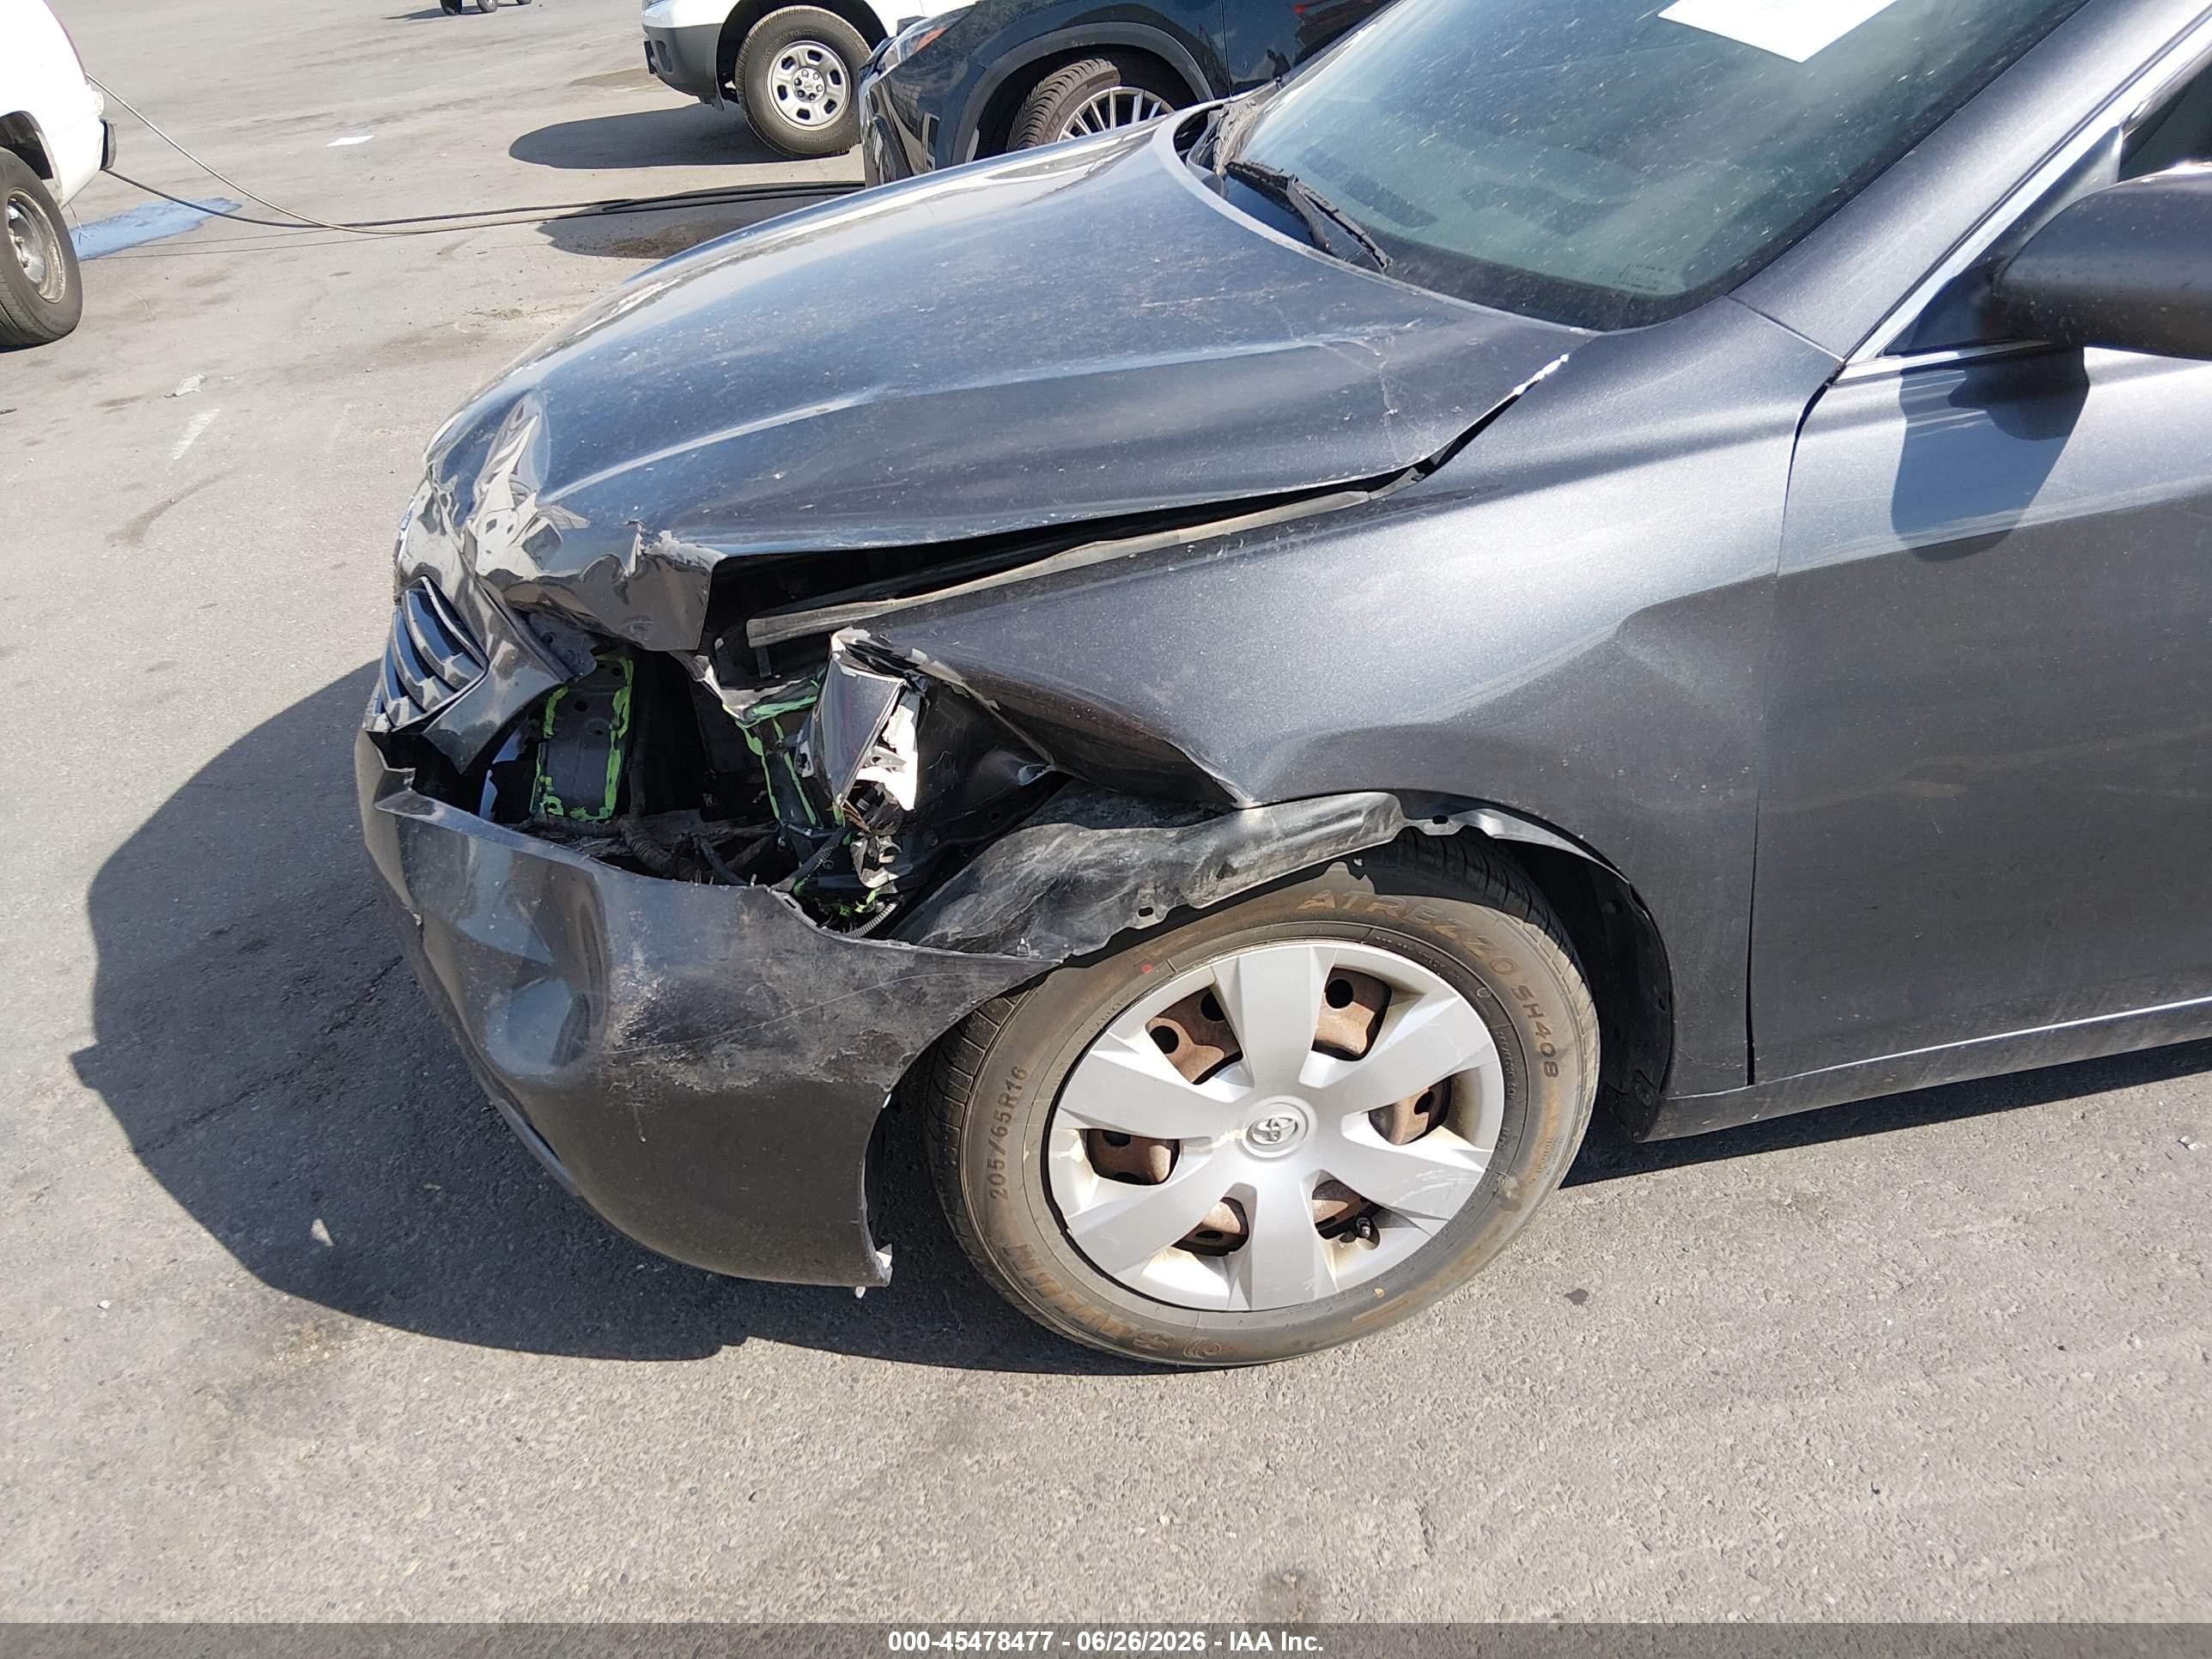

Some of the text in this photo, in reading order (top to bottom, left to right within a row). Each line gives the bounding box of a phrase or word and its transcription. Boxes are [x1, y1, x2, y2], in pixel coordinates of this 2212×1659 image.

[1297, 889, 1519, 975] ATREZZO
[1510, 984, 1560, 1079] SH408
[986, 1065, 1029, 1201] 205/65R16
